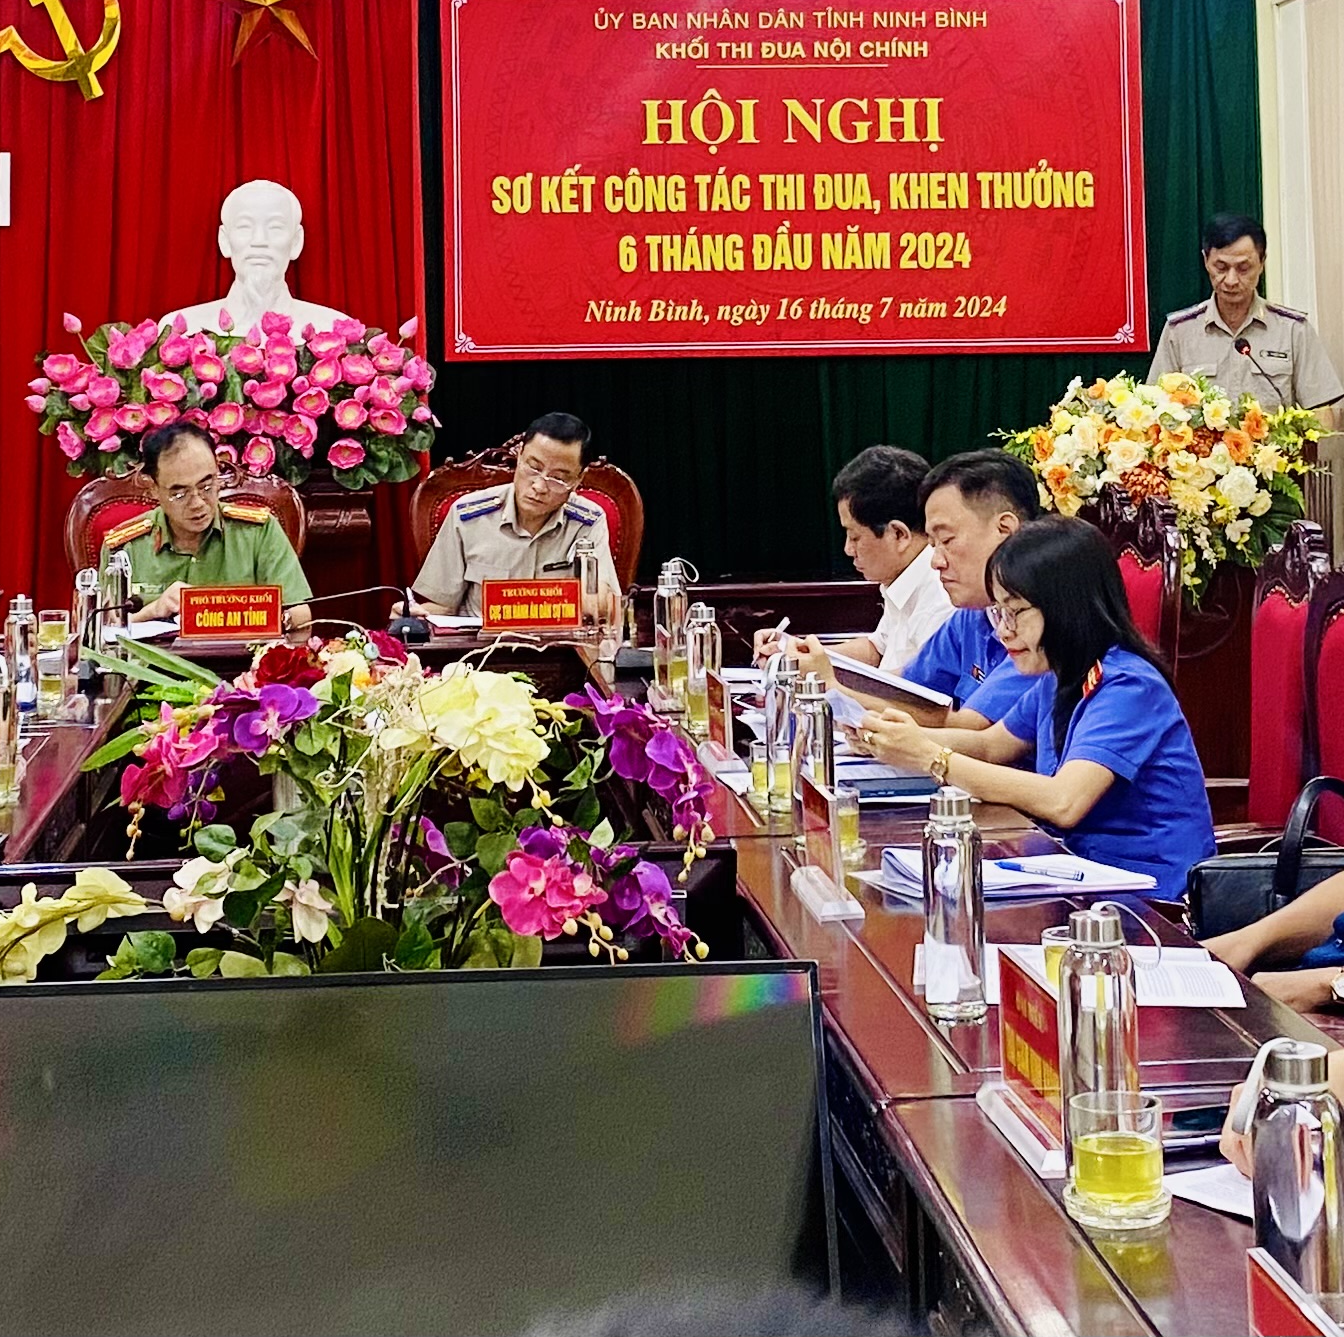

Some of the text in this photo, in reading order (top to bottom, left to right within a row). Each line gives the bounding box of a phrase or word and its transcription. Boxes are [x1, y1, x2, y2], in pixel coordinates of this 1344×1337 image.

[594, 6, 987, 30] ỦY BAN NHÂN DÂN TỈNH NINH BÌNH
[655, 35, 929, 63] KHỐI THI ĐUA NỘI CHÍNH
[641, 87, 945, 155] HỘI NGHỊ
[491, 158, 1095, 215] SƠ KẾT CÔNG TÁC THI ĐUA, KHEN THƯỞNG
[618, 220, 972, 273] 6 THÁNG ĐẦU NĂM 2024
[584, 295, 1007, 326] Ninh Bình, ngày 16 tháng 7 năm 2024
[196, 606, 267, 627] CÔNG AN TỈNH
